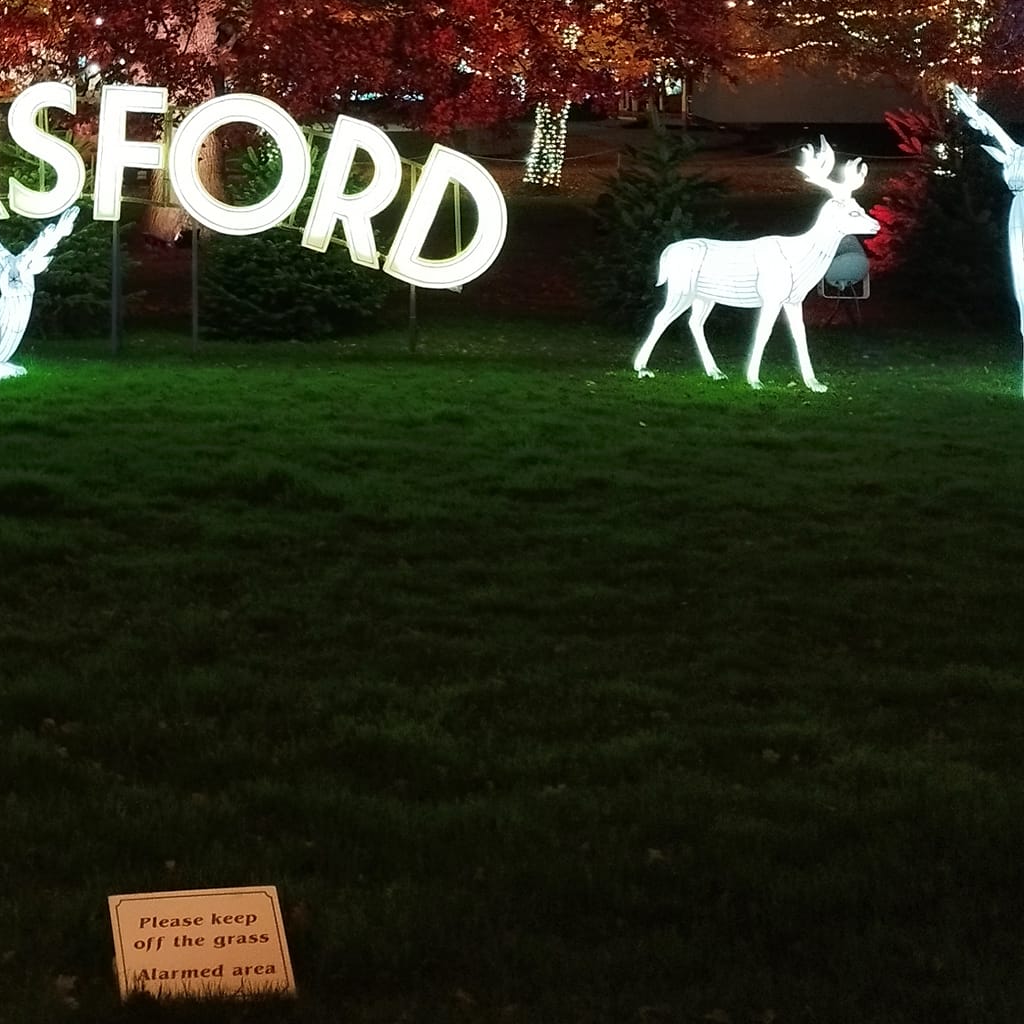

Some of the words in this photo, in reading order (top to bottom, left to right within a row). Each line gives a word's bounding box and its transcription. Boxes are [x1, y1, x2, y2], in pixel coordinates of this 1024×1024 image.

[140, 915, 204, 929] Please
[211, 912, 257, 926] keep
[134, 936, 166, 952] off
[174, 934, 205, 948] the
[213, 933, 270, 949] grass
[138, 964, 224, 981] Alarmed
[232, 963, 276, 976] area
